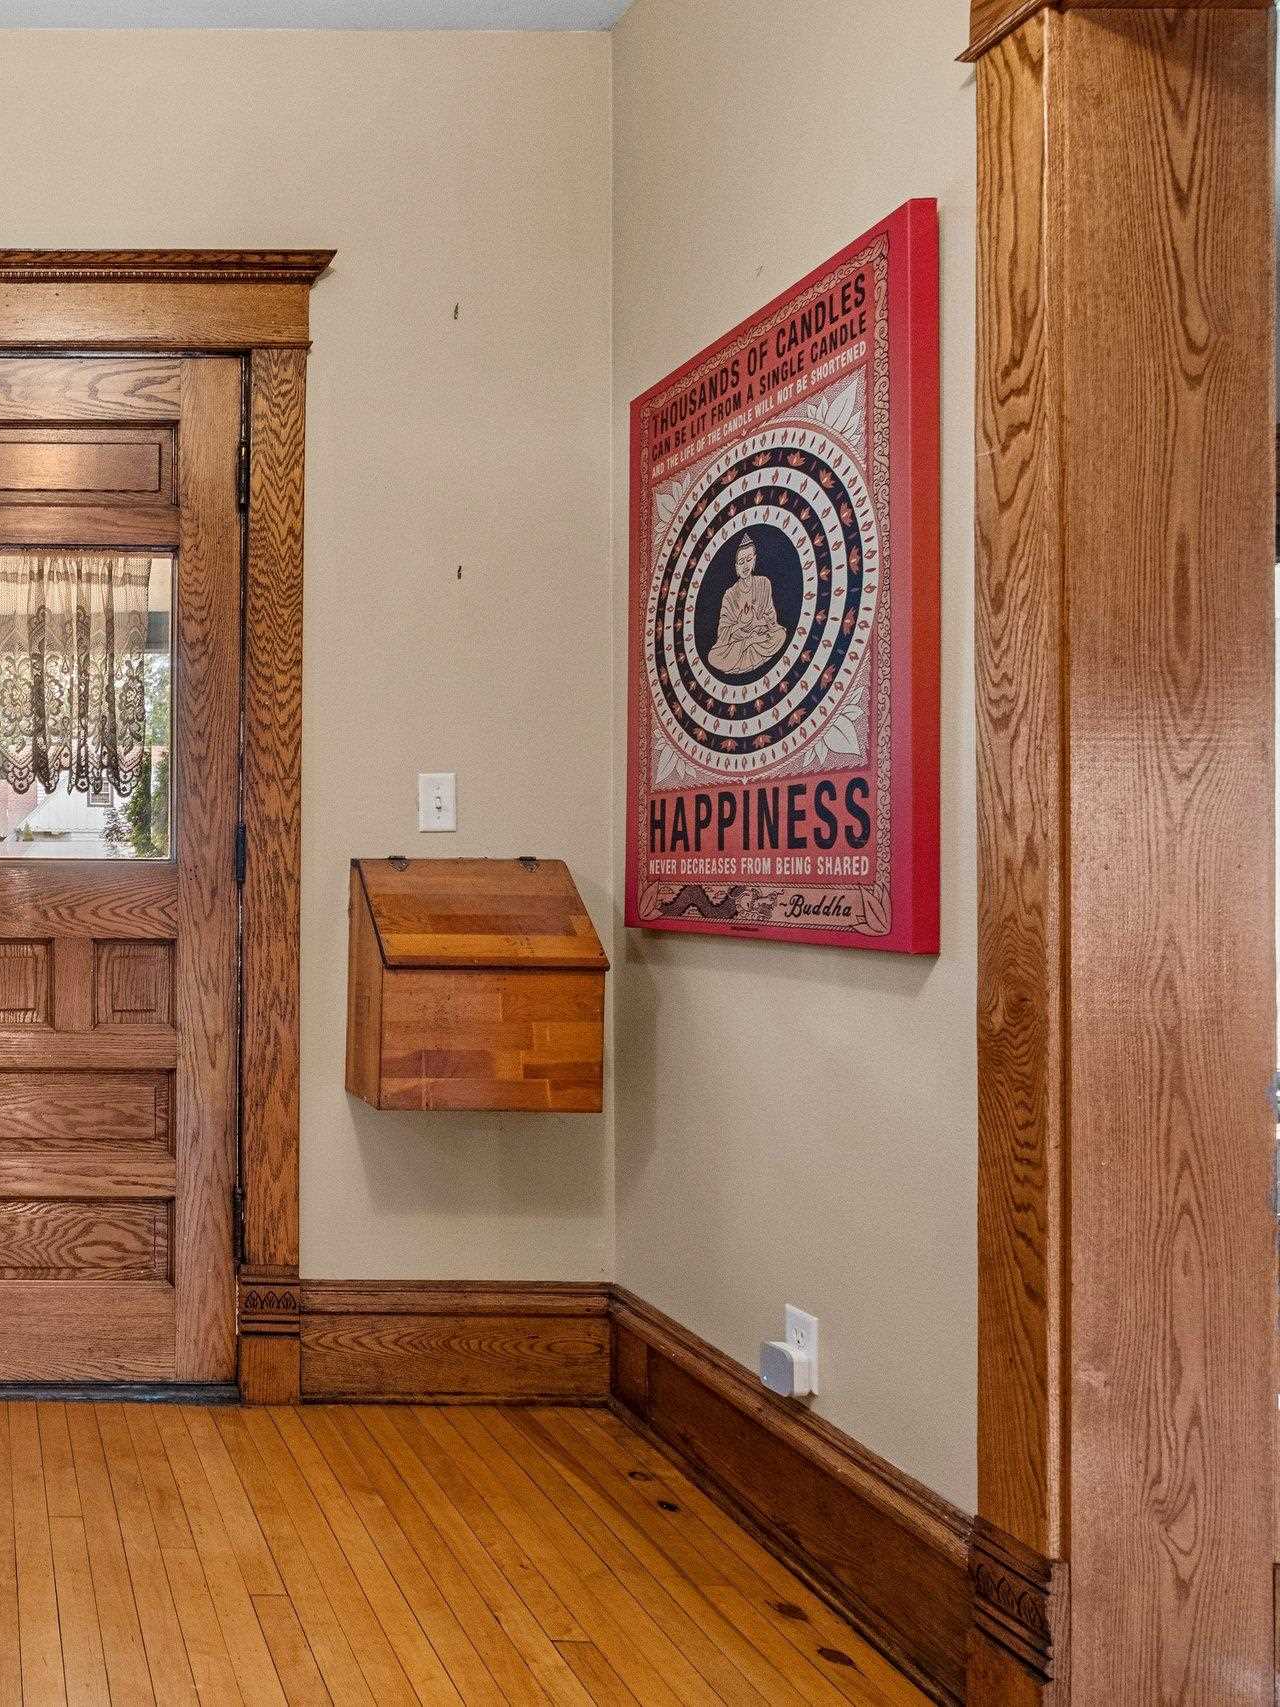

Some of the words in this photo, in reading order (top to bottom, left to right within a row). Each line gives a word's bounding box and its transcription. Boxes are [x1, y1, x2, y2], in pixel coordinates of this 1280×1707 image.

[652, 360, 739, 438] THOUSANDS
[747, 340, 768, 377] OF
[776, 273, 866, 358] CANDLES
[652, 436, 671, 461] CAN
[674, 426, 687, 448] BE
[691, 412, 707, 439] LIT
[711, 390, 742, 425] FROM
[747, 384, 754, 404] A
[759, 350, 804, 395] SINGLE
[810, 310, 866, 363] CANDLE
[708, 429, 721, 445] THE
[723, 409, 753, 436] CANDLE
[754, 396, 774, 417] WILL
[777, 383, 793, 405] NOT
[796, 374, 808, 394] BE
[811, 341, 866, 385] SHORTENED
[649, 859, 677, 875] NEVER
[681, 857, 737, 875] DECREASES
[741, 857, 771, 875] FROM
[776, 856, 811, 876] BEING
[817, 855, 869, 876] SHARED
[650, 776, 870, 852] HAPPINESS
